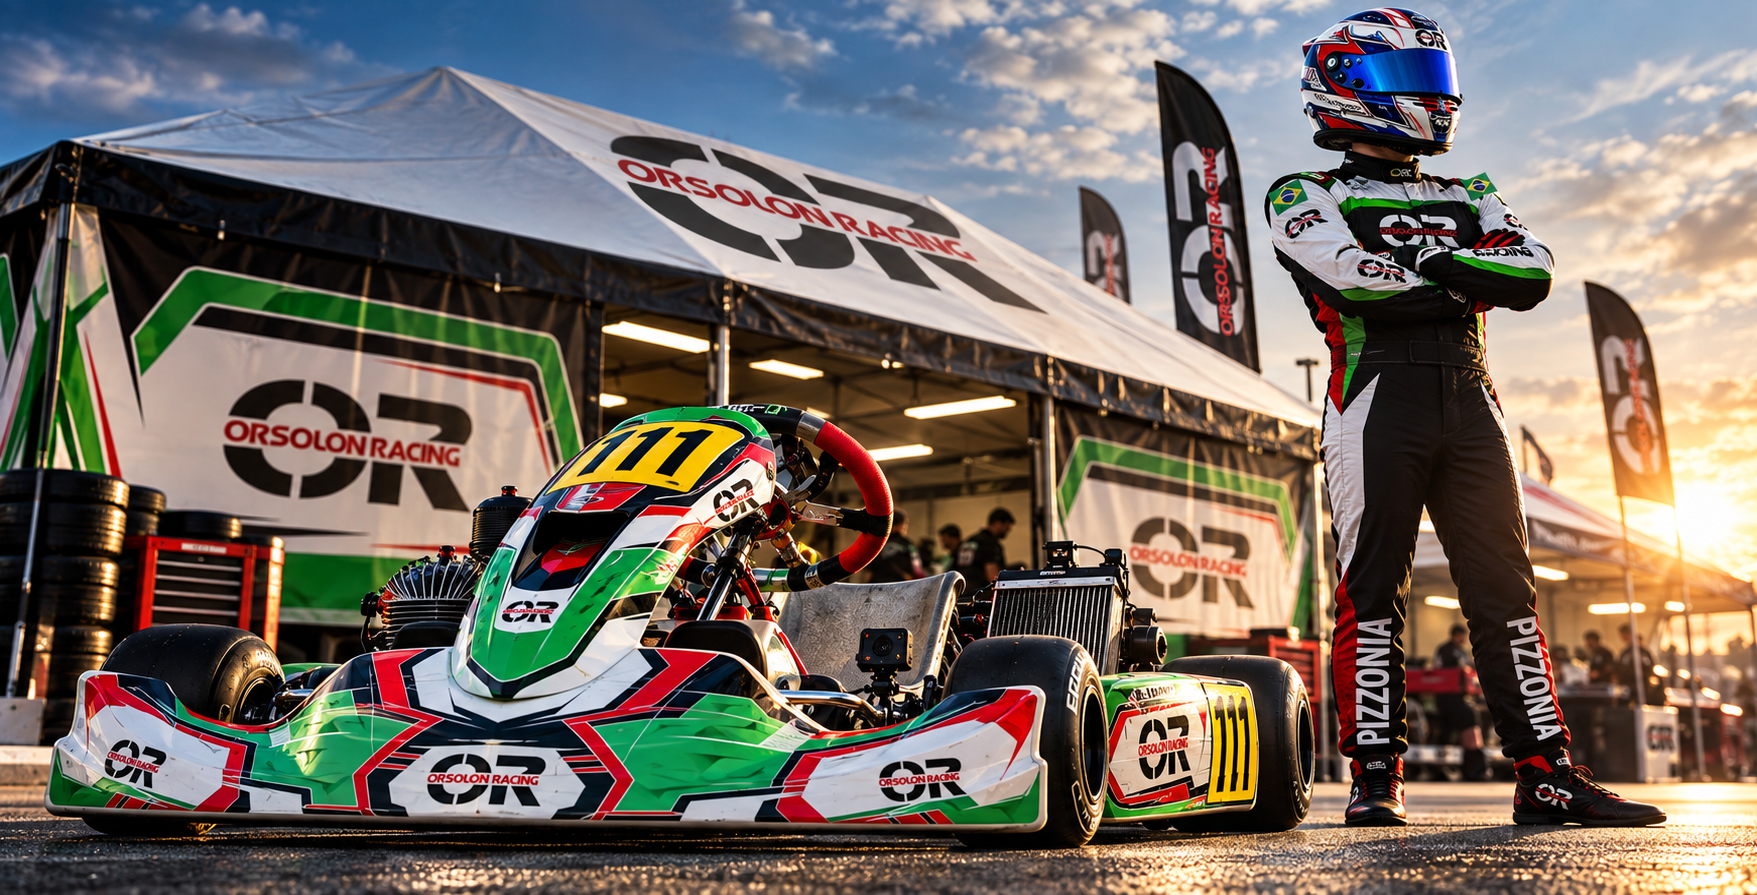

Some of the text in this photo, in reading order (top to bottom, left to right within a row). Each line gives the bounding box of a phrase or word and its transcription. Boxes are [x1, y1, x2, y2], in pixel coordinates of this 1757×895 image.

[1415, 29, 1448, 50] OR
[618, 159, 978, 262] ORSOLON RACING
[1201, 146, 1223, 226] RACING
[611, 135, 1048, 314] OR
[1172, 140, 1245, 336] OR
[1285, 209, 1329, 239] OR
[1379, 213, 1460, 249] OR
[1357, 259, 1407, 283] OR
[223, 420, 461, 468] ORSOLON RACING
[223, 379, 472, 512] OR
[577, 426, 714, 477] 111
[713, 478, 760, 522] OR
[1129, 545, 1247, 577] ORSOLON RACING
[1131, 516, 1254, 610] OR
[502, 600, 559, 623] OR
[1355, 617, 1392, 746] PIZZONIA
[1506, 615, 1562, 742] PIZZONIA
[104, 739, 167, 789] OR
[1139, 714, 1191, 780] OR
[1214, 695, 1250, 793] 111
[427, 773, 540, 786] ORSOLON RACING
[427, 753, 546, 807] OR
[878, 772, 960, 787] ORSOLON RACING
[879, 757, 967, 802] OR
[1535, 783, 1573, 811] OR
